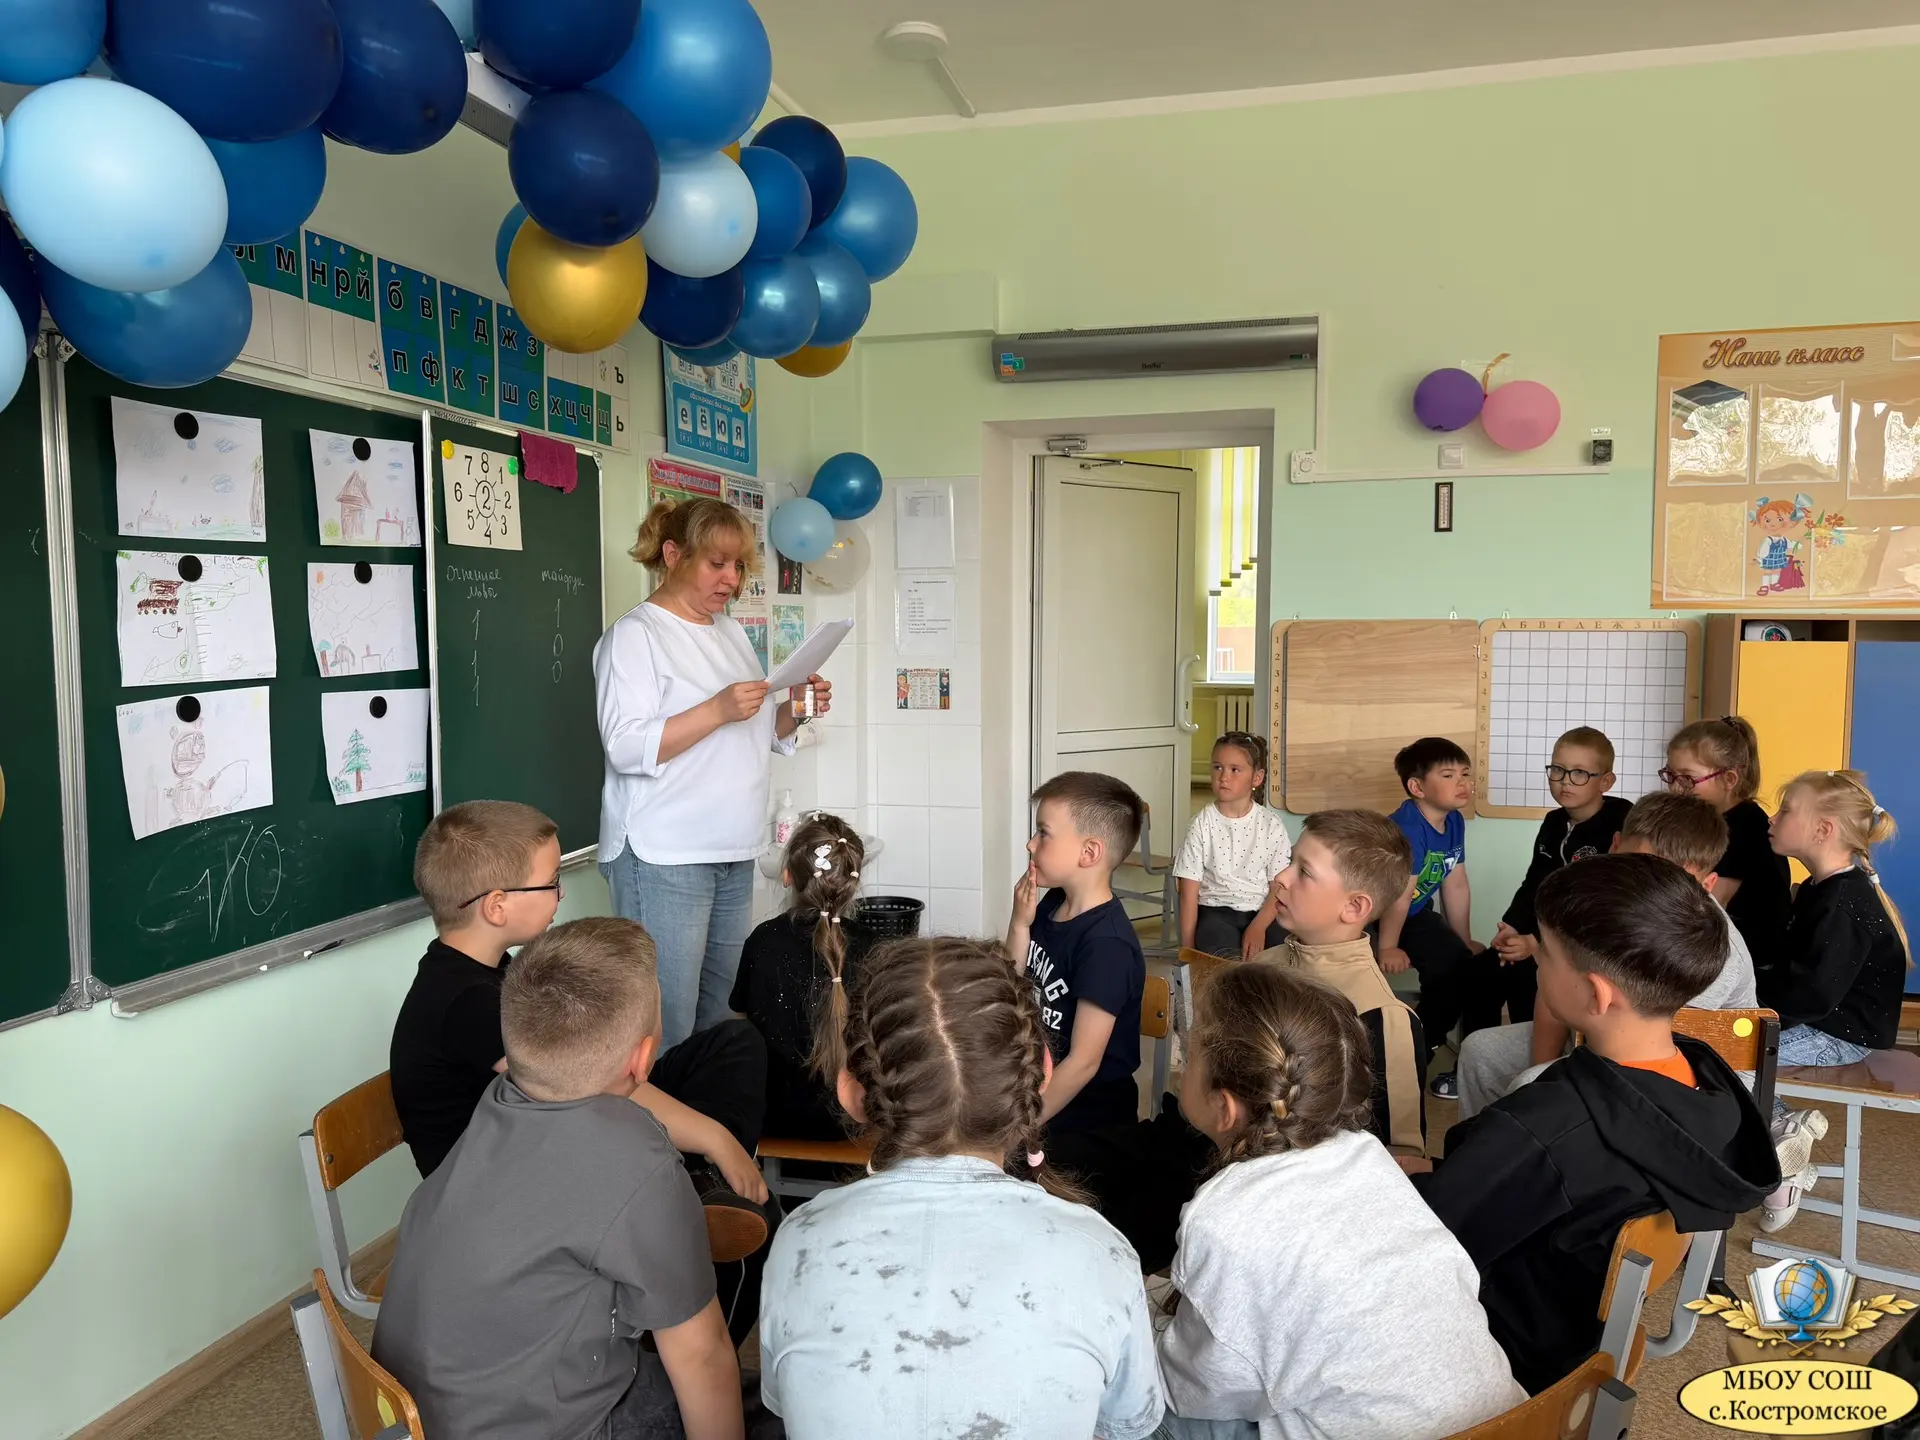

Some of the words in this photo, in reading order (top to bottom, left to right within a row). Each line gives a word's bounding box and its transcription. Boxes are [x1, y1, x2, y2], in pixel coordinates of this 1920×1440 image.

[275, 244, 296, 275] м
[310, 259, 328, 287] н
[334, 266, 351, 299] р
[356, 267, 371, 302] й
[387, 280, 403, 311] б
[420, 295, 434, 320] в
[450, 308, 460, 329] г
[474, 317, 488, 345] д
[392, 349, 408, 374] п
[421, 351, 440, 387] ф
[1703, 338, 1781, 368] Наш
[1786, 345, 1864, 364] класс
[452, 366, 465, 390] к
[477, 374, 488, 396] т
[681, 407, 688, 425] е
[700, 407, 708, 431] ё
[717, 418, 727, 437] ю
[736, 425, 742, 442] я
[464, 455, 473, 476] 7
[481, 452, 490, 474] 8
[498, 467, 504, 484] 1
[454, 482, 463, 502] 6
[482, 485, 491, 511] 2
[504, 491, 512, 509] 2
[467, 510, 475, 530] 5
[500, 515, 508, 535] 3
[484, 525, 492, 545] 4
[1026, 940, 1069, 1003] IKING
[1042, 1006, 1063, 1030] 82
